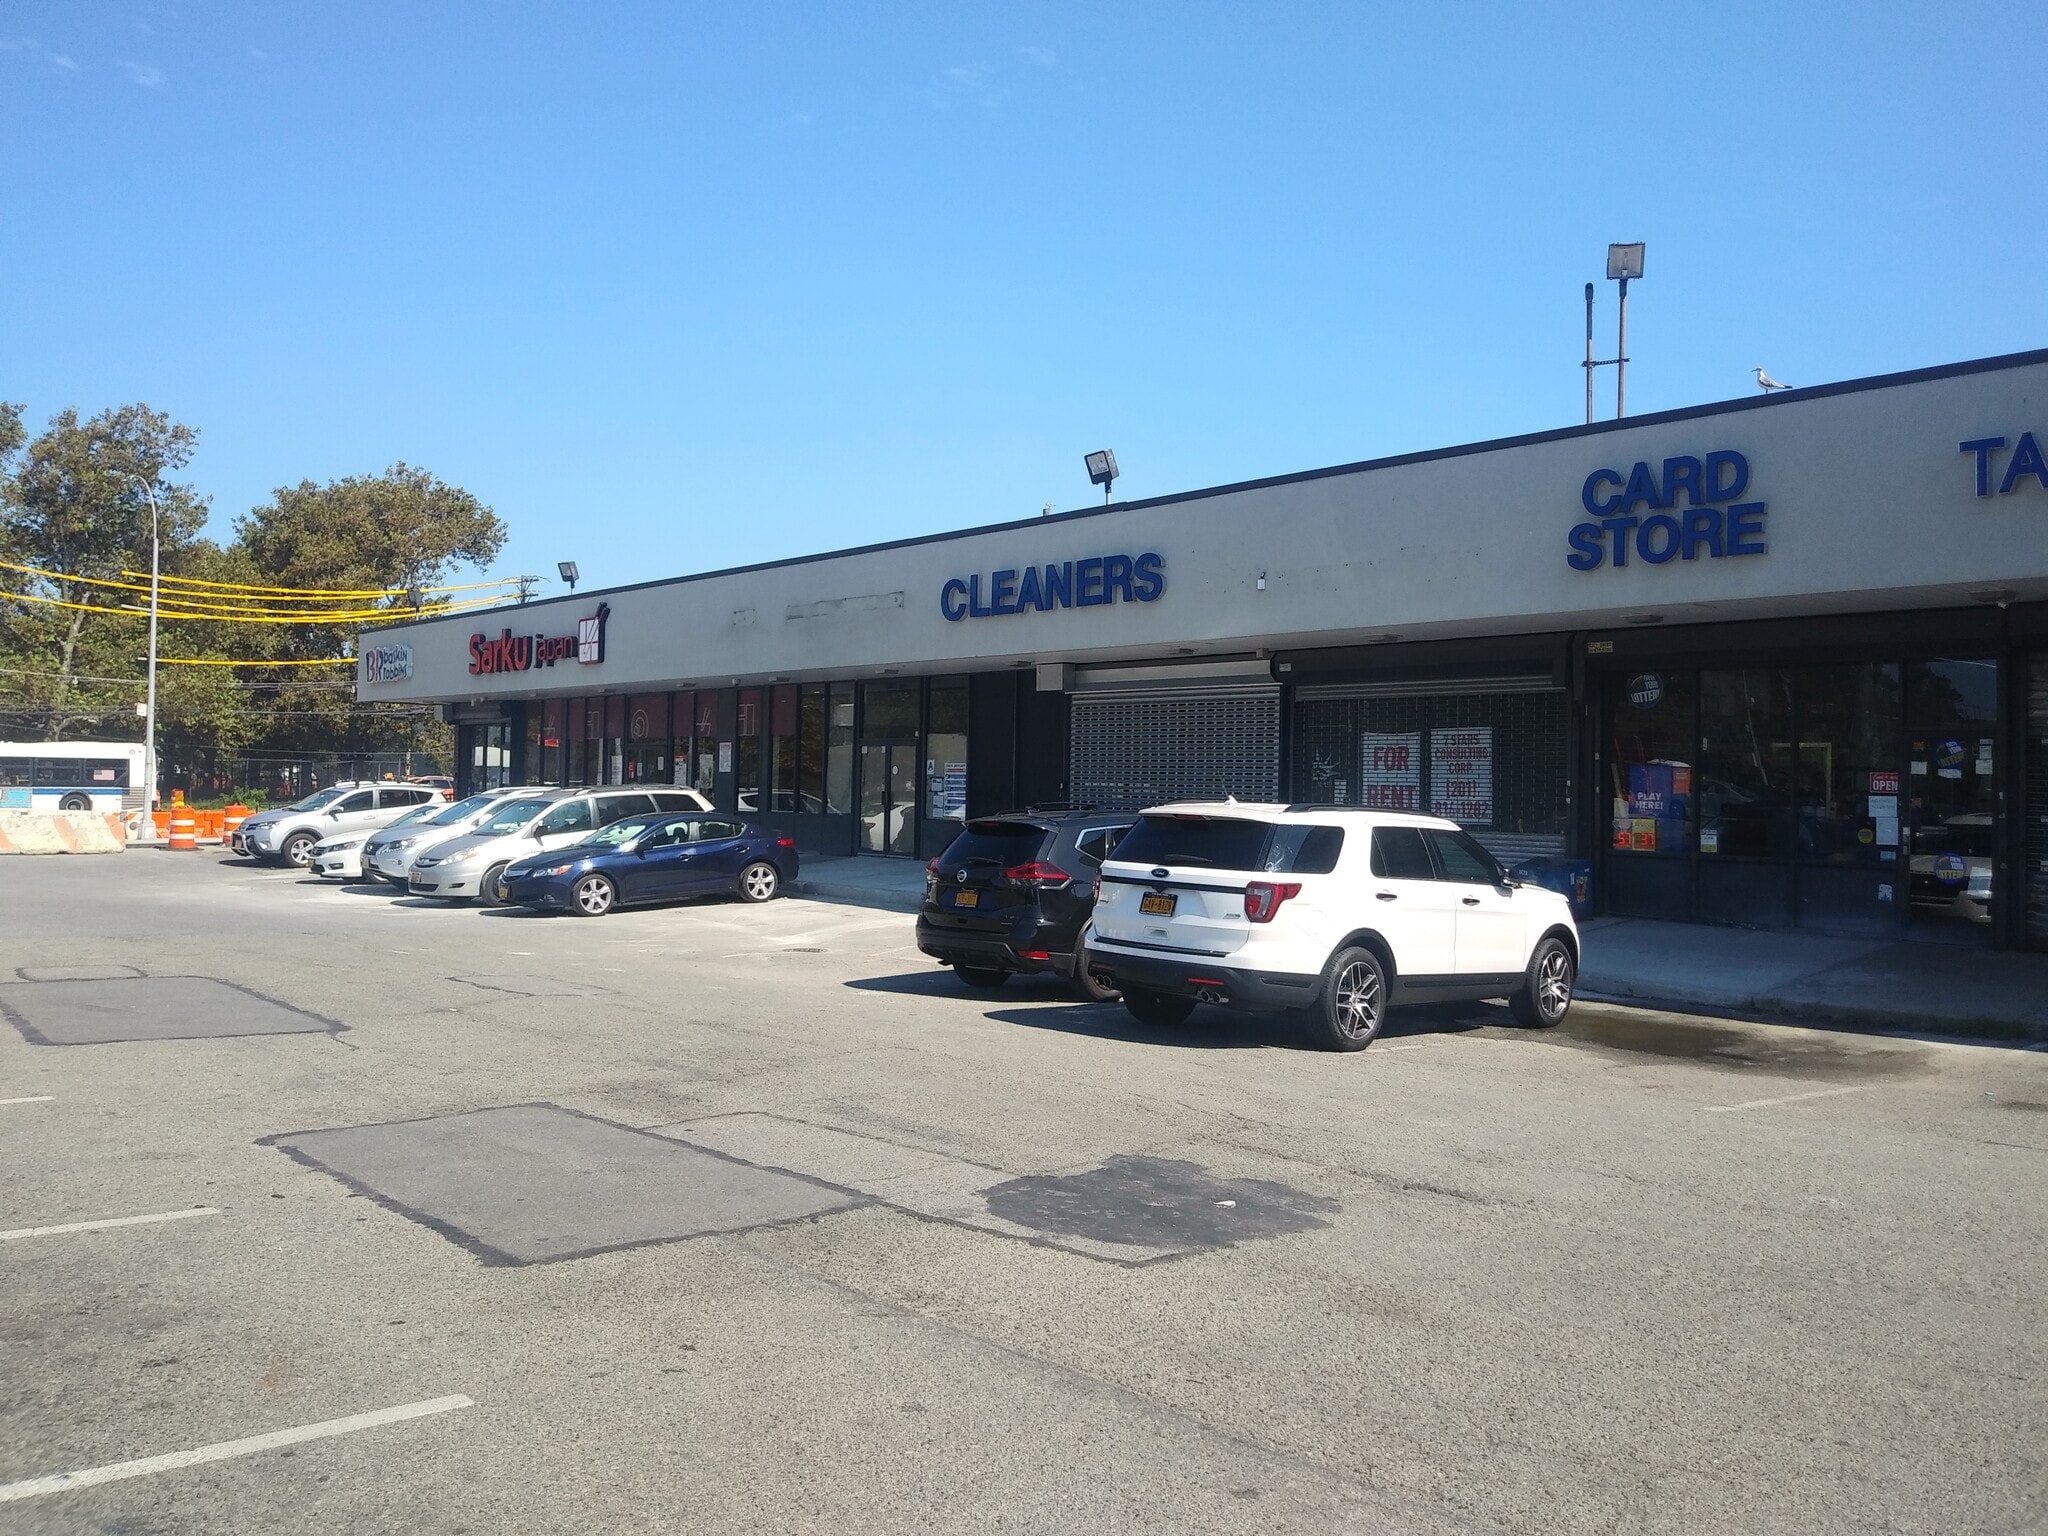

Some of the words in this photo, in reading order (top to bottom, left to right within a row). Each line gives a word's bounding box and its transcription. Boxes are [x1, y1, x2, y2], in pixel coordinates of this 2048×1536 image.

[1581, 450, 1750, 517] CARD
[1566, 501, 1767, 571] STORE
[940, 552, 1165, 622] CLEANERS
[469, 628, 532, 675] Sarku
[534, 633, 579, 668] japan
[1450, 734, 1480, 746] STARS
[1373, 745, 1410, 771] FOR
[1434, 748, 1489, 760] CONSULTING
[1448, 762, 1475, 775] CORP.
[1872, 780, 1899, 791] OPEN
[1366, 784, 1416, 808] RENT
[1635, 800, 1664, 810] HERE!
[1637, 791, 1662, 801] PLAY
